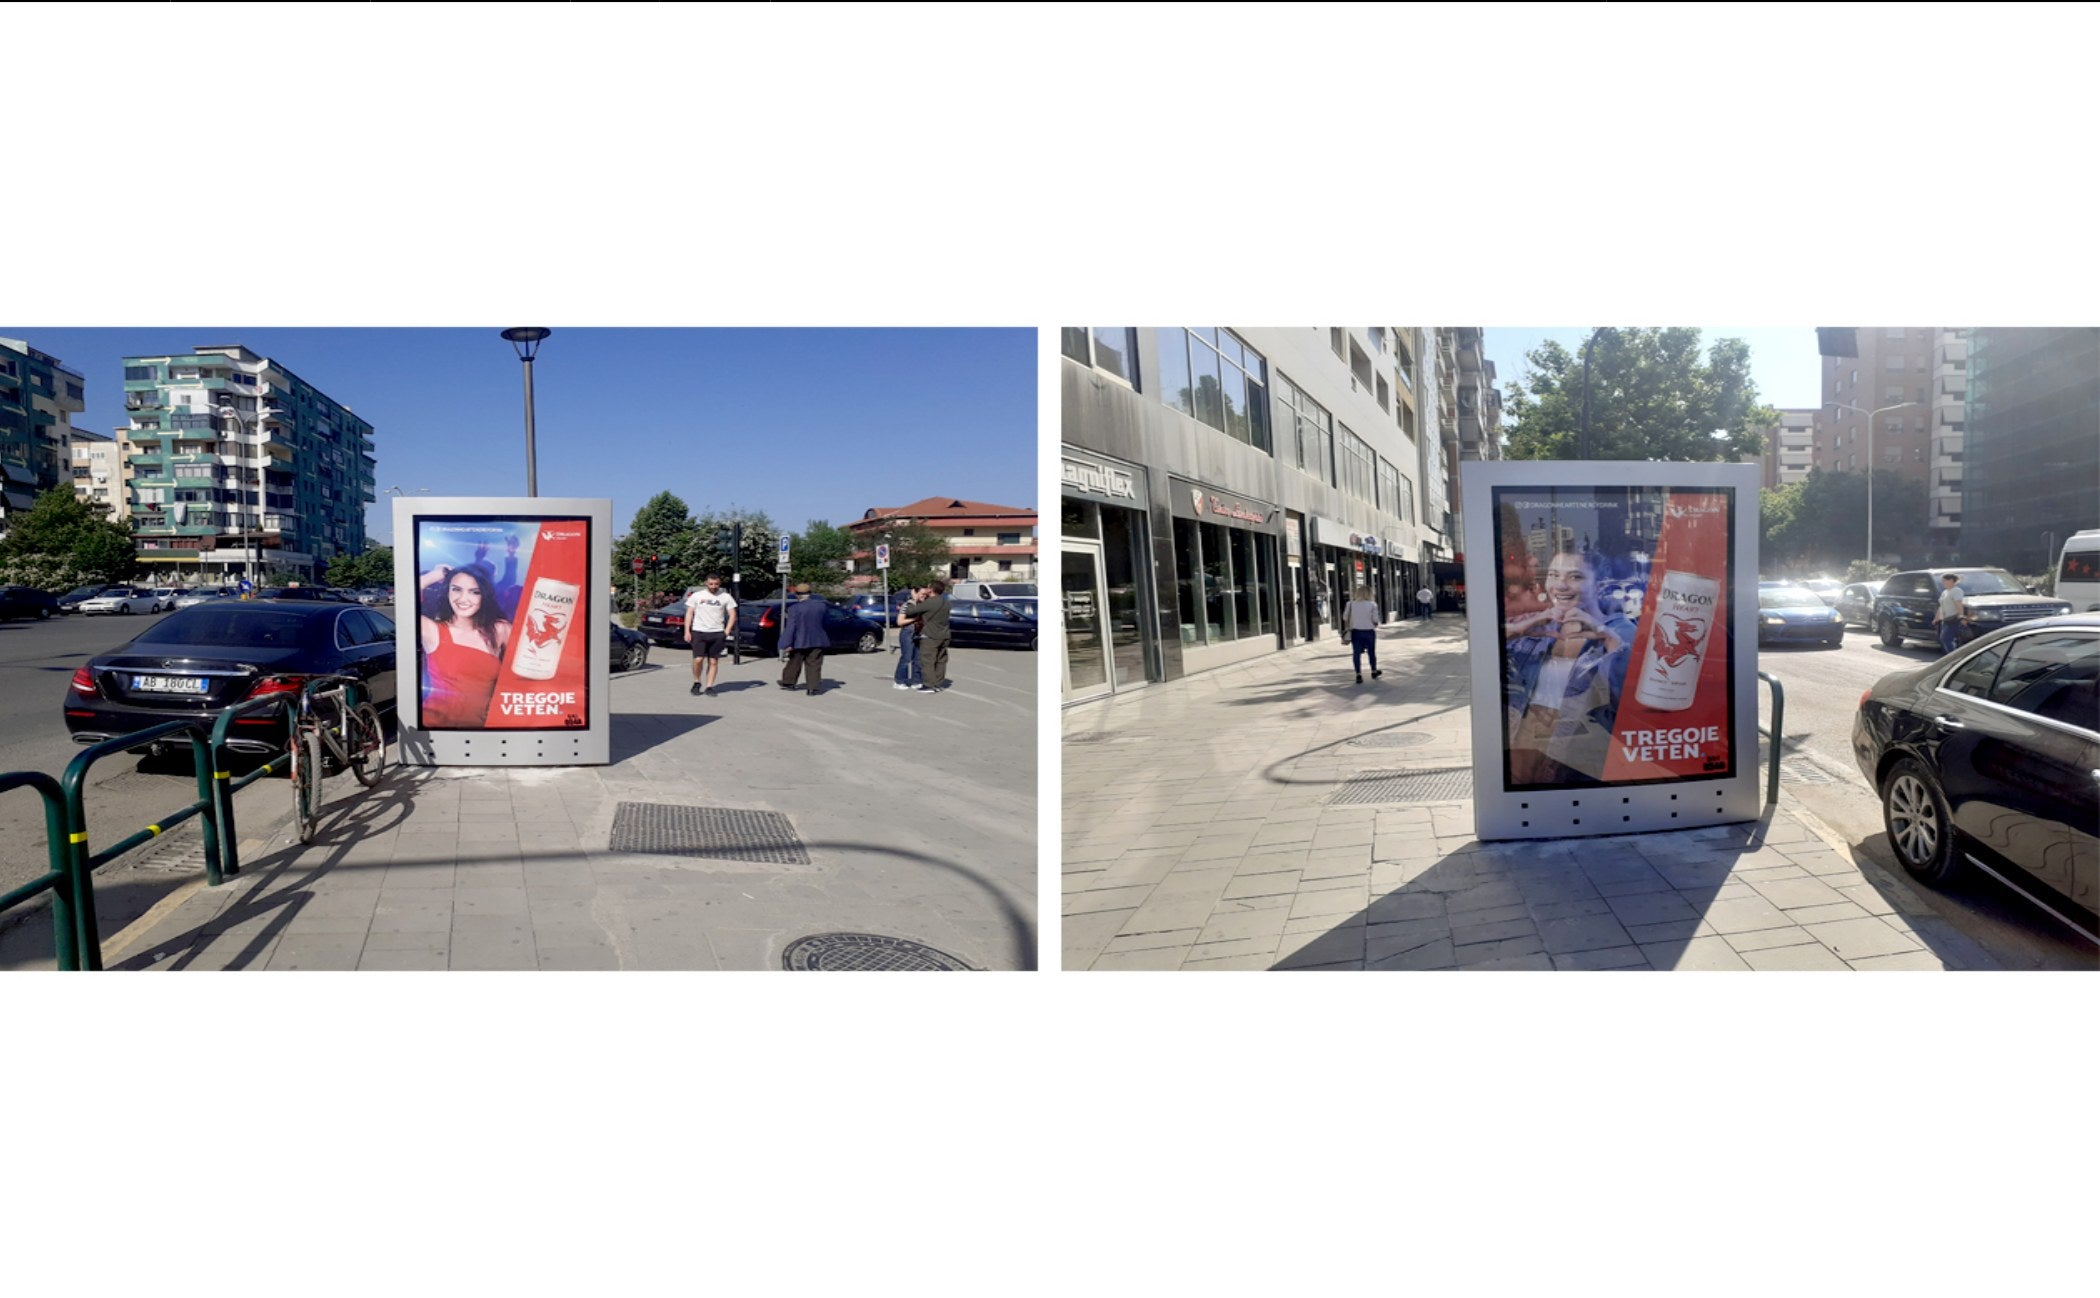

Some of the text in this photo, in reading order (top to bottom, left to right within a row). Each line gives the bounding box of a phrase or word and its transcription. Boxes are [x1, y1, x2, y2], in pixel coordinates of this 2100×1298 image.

[534, 590, 574, 605] DRAGON
[1662, 588, 1714, 605] DRAGON
[500, 692, 577, 705] TREGOJE
[1621, 726, 1720, 746] TREGOJE
